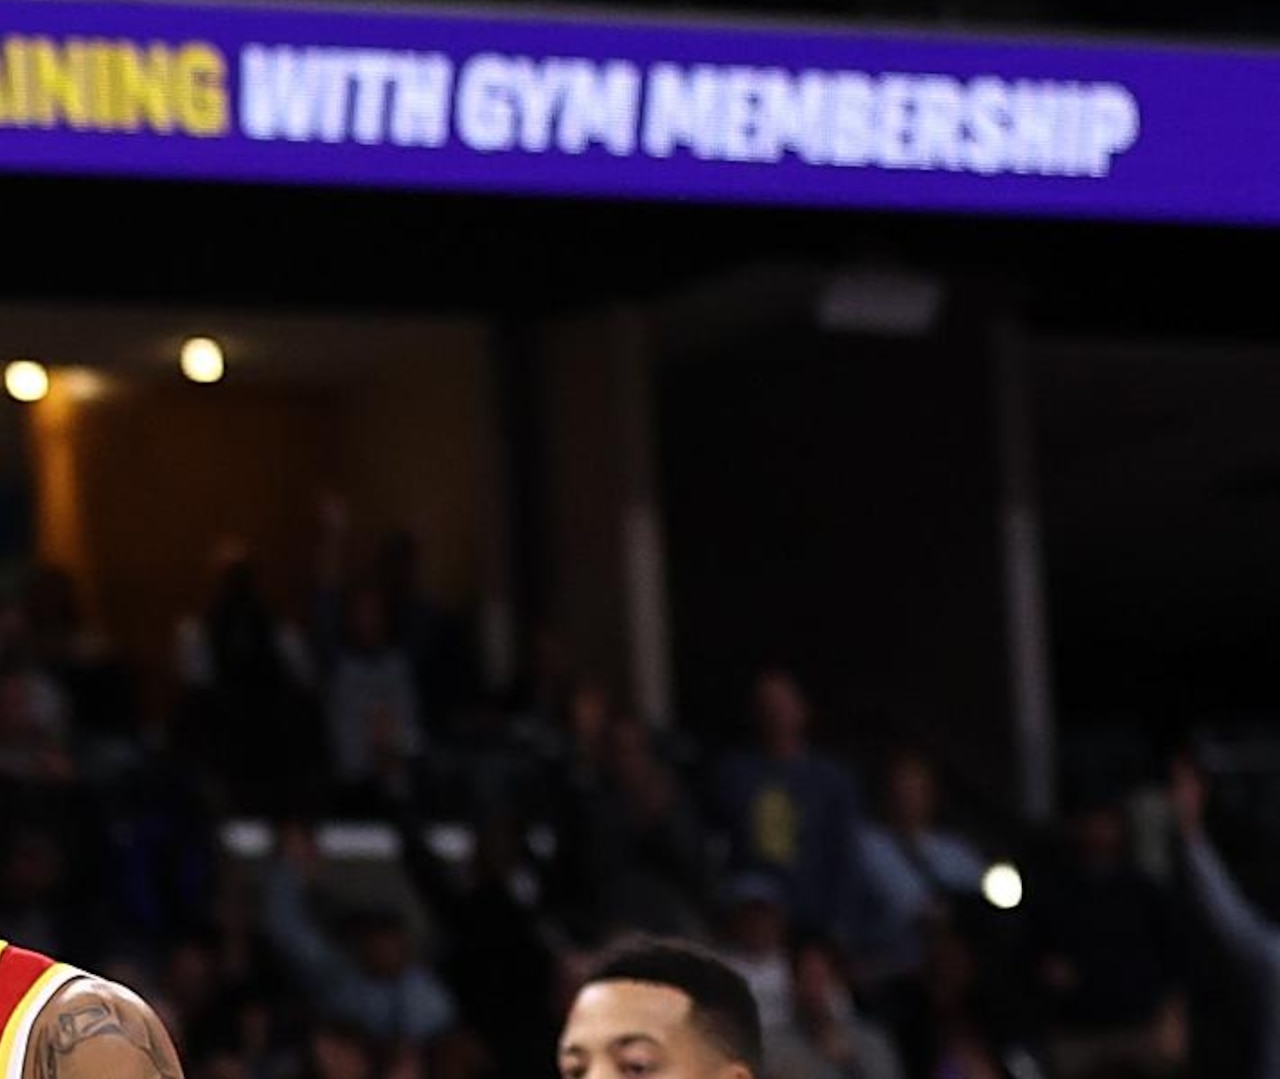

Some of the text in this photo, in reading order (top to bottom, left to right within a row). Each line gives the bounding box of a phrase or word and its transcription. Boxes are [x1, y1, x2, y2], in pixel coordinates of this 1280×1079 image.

[240, 42, 453, 147] WITH
[456, 52, 639, 157] GYM
[641, 60, 1140, 177] MEMBERSHIP
